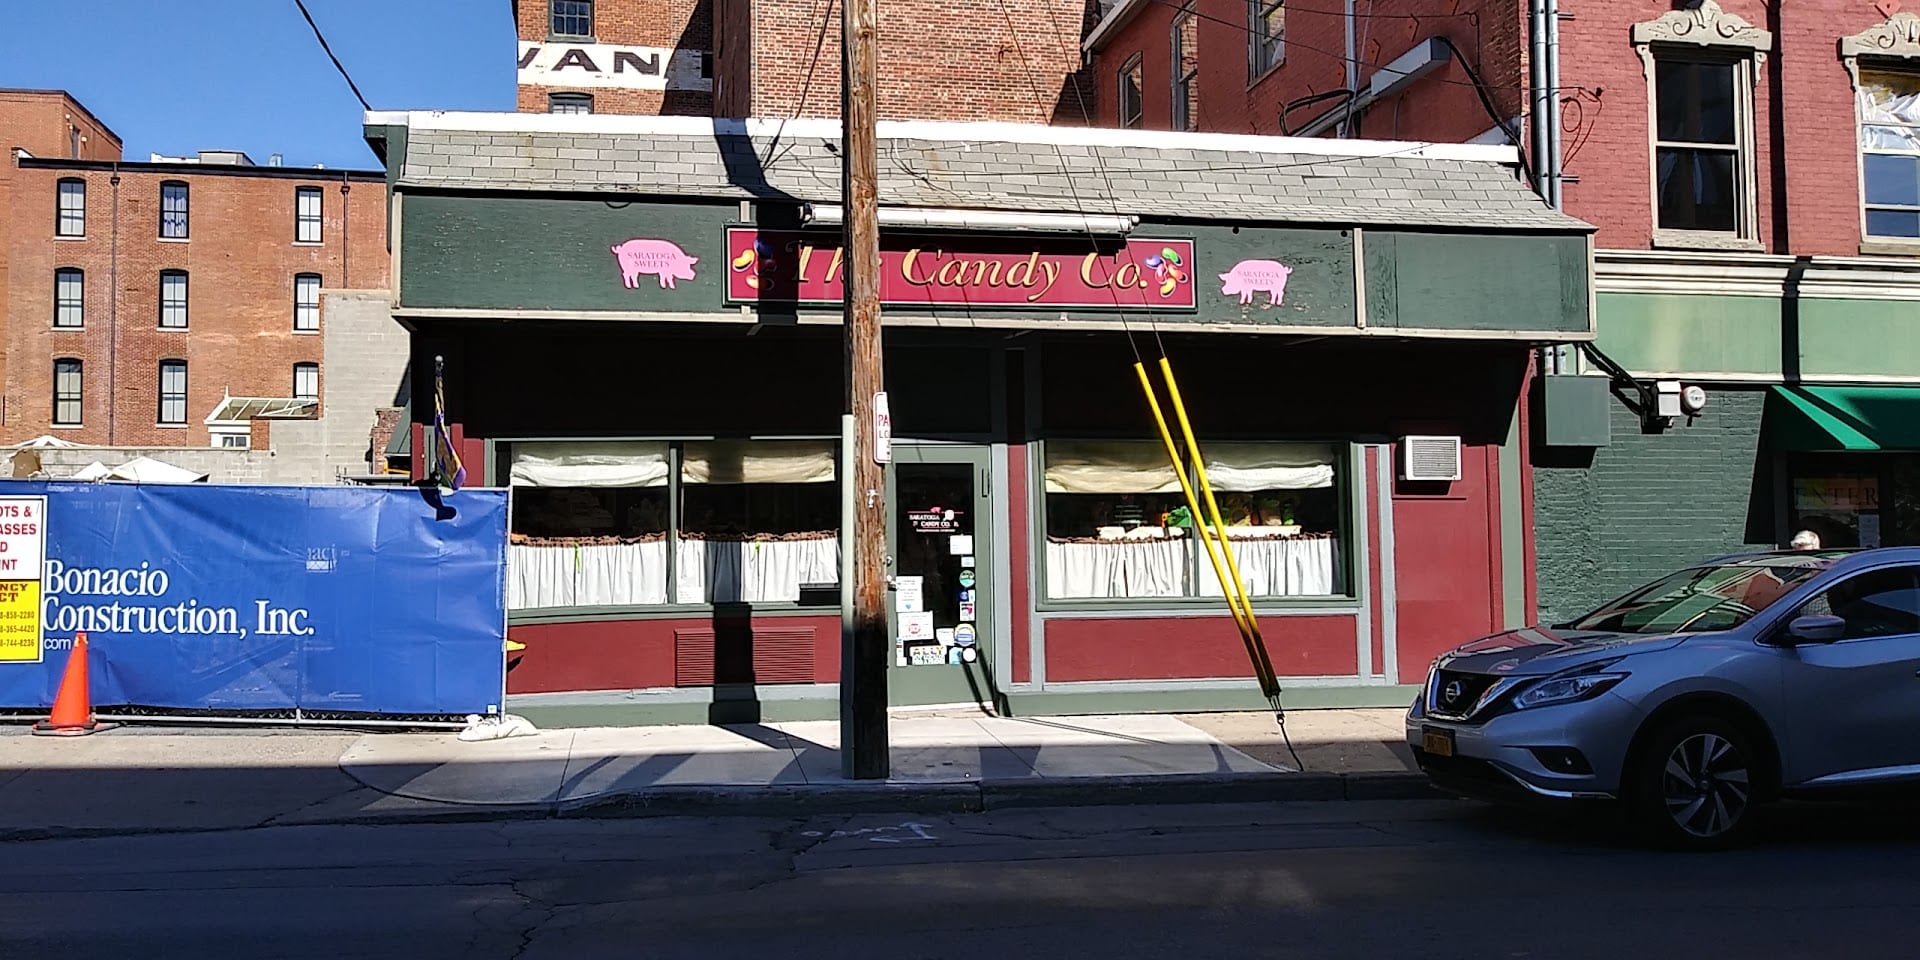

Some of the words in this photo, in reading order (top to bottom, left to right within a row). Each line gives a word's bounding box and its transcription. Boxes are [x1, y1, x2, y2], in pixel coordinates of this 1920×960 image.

[627, 252, 677, 260] SARATOGA
[634, 260, 670, 268] SWEETS
[785, 240, 882, 284] Th
[901, 246, 1061, 302] Candy
[1080, 248, 1149, 289] Co.
[1237, 270, 1280, 278] SARATOGA
[1243, 278, 1275, 286] SWEETS
[1795, 486, 1879, 506] ENTER
[23, 505, 32, 518] &
[44, 560, 169, 597] Bonacio
[43, 596, 248, 640] Construction,
[254, 600, 315, 636] Inc.
